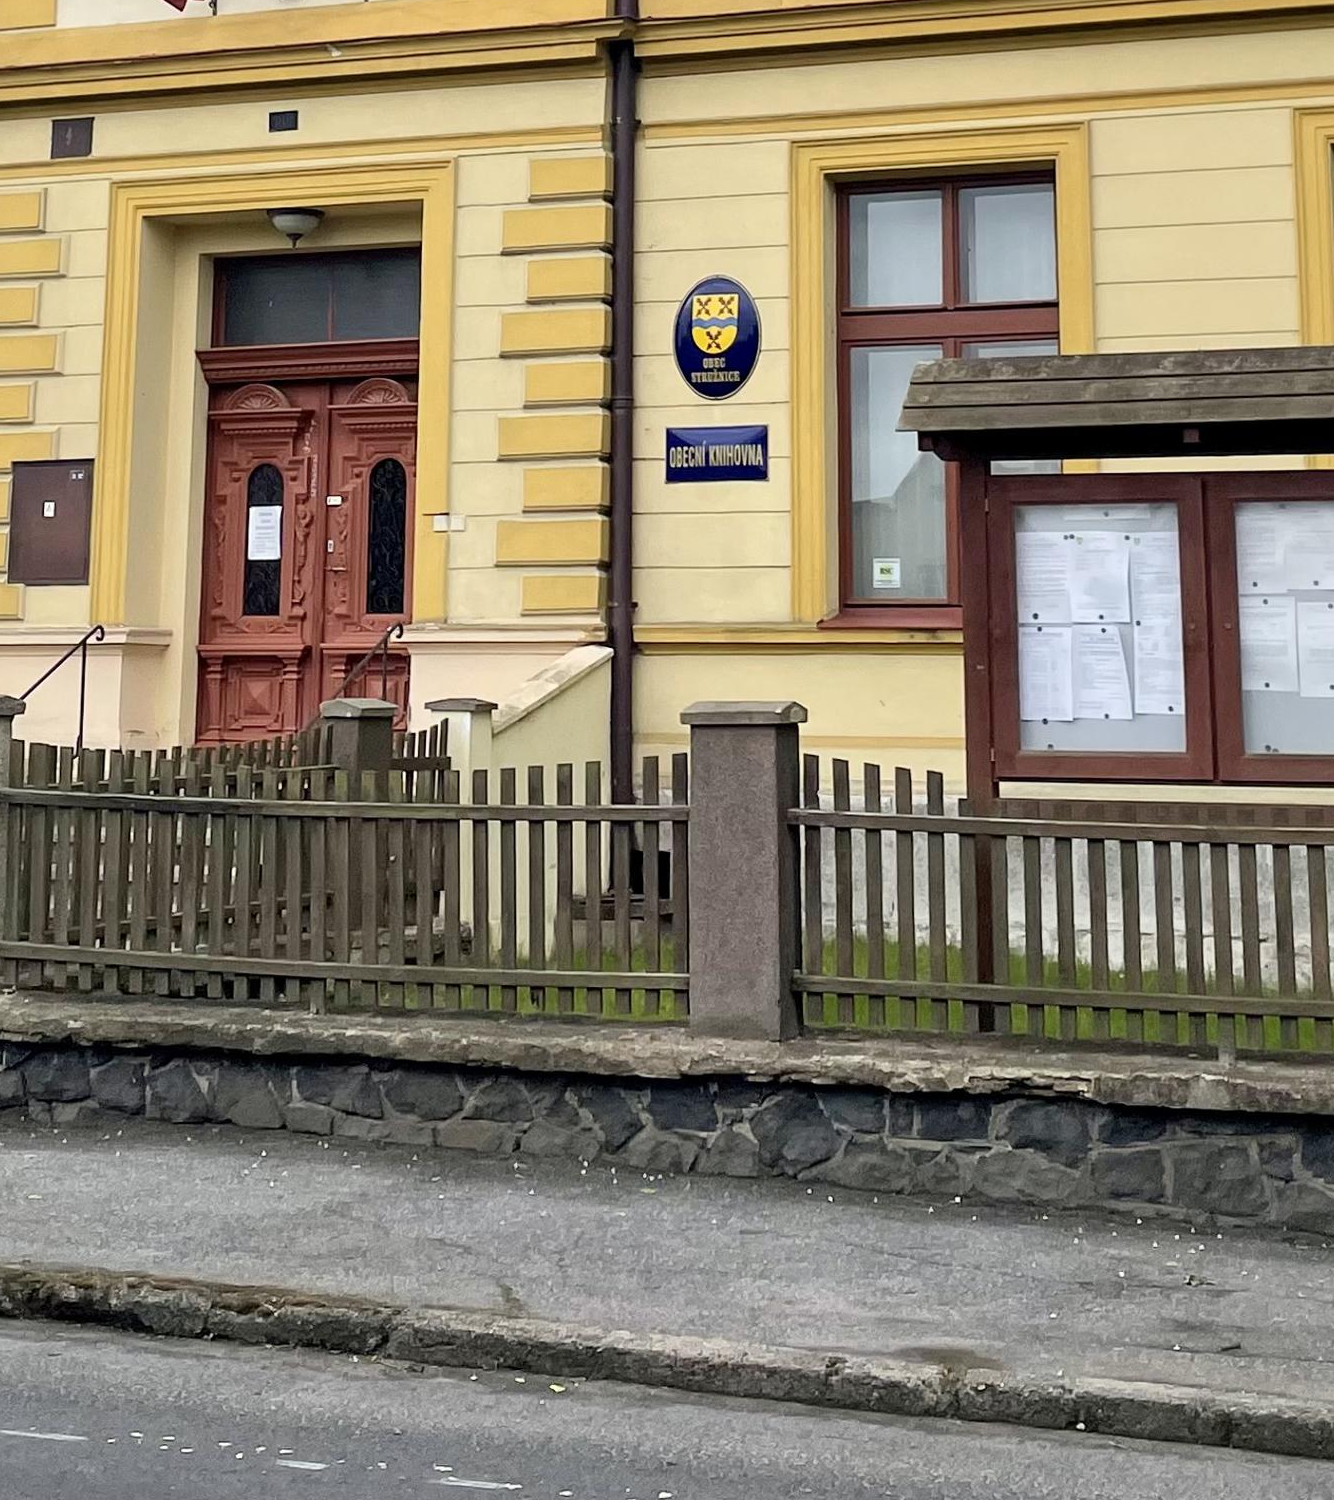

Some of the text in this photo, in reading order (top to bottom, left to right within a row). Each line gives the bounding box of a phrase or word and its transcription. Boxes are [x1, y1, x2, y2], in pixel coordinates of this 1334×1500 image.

[702, 357, 726, 369] OBEC
[669, 440, 764, 468] OBECNÍ KNIHOVNA
